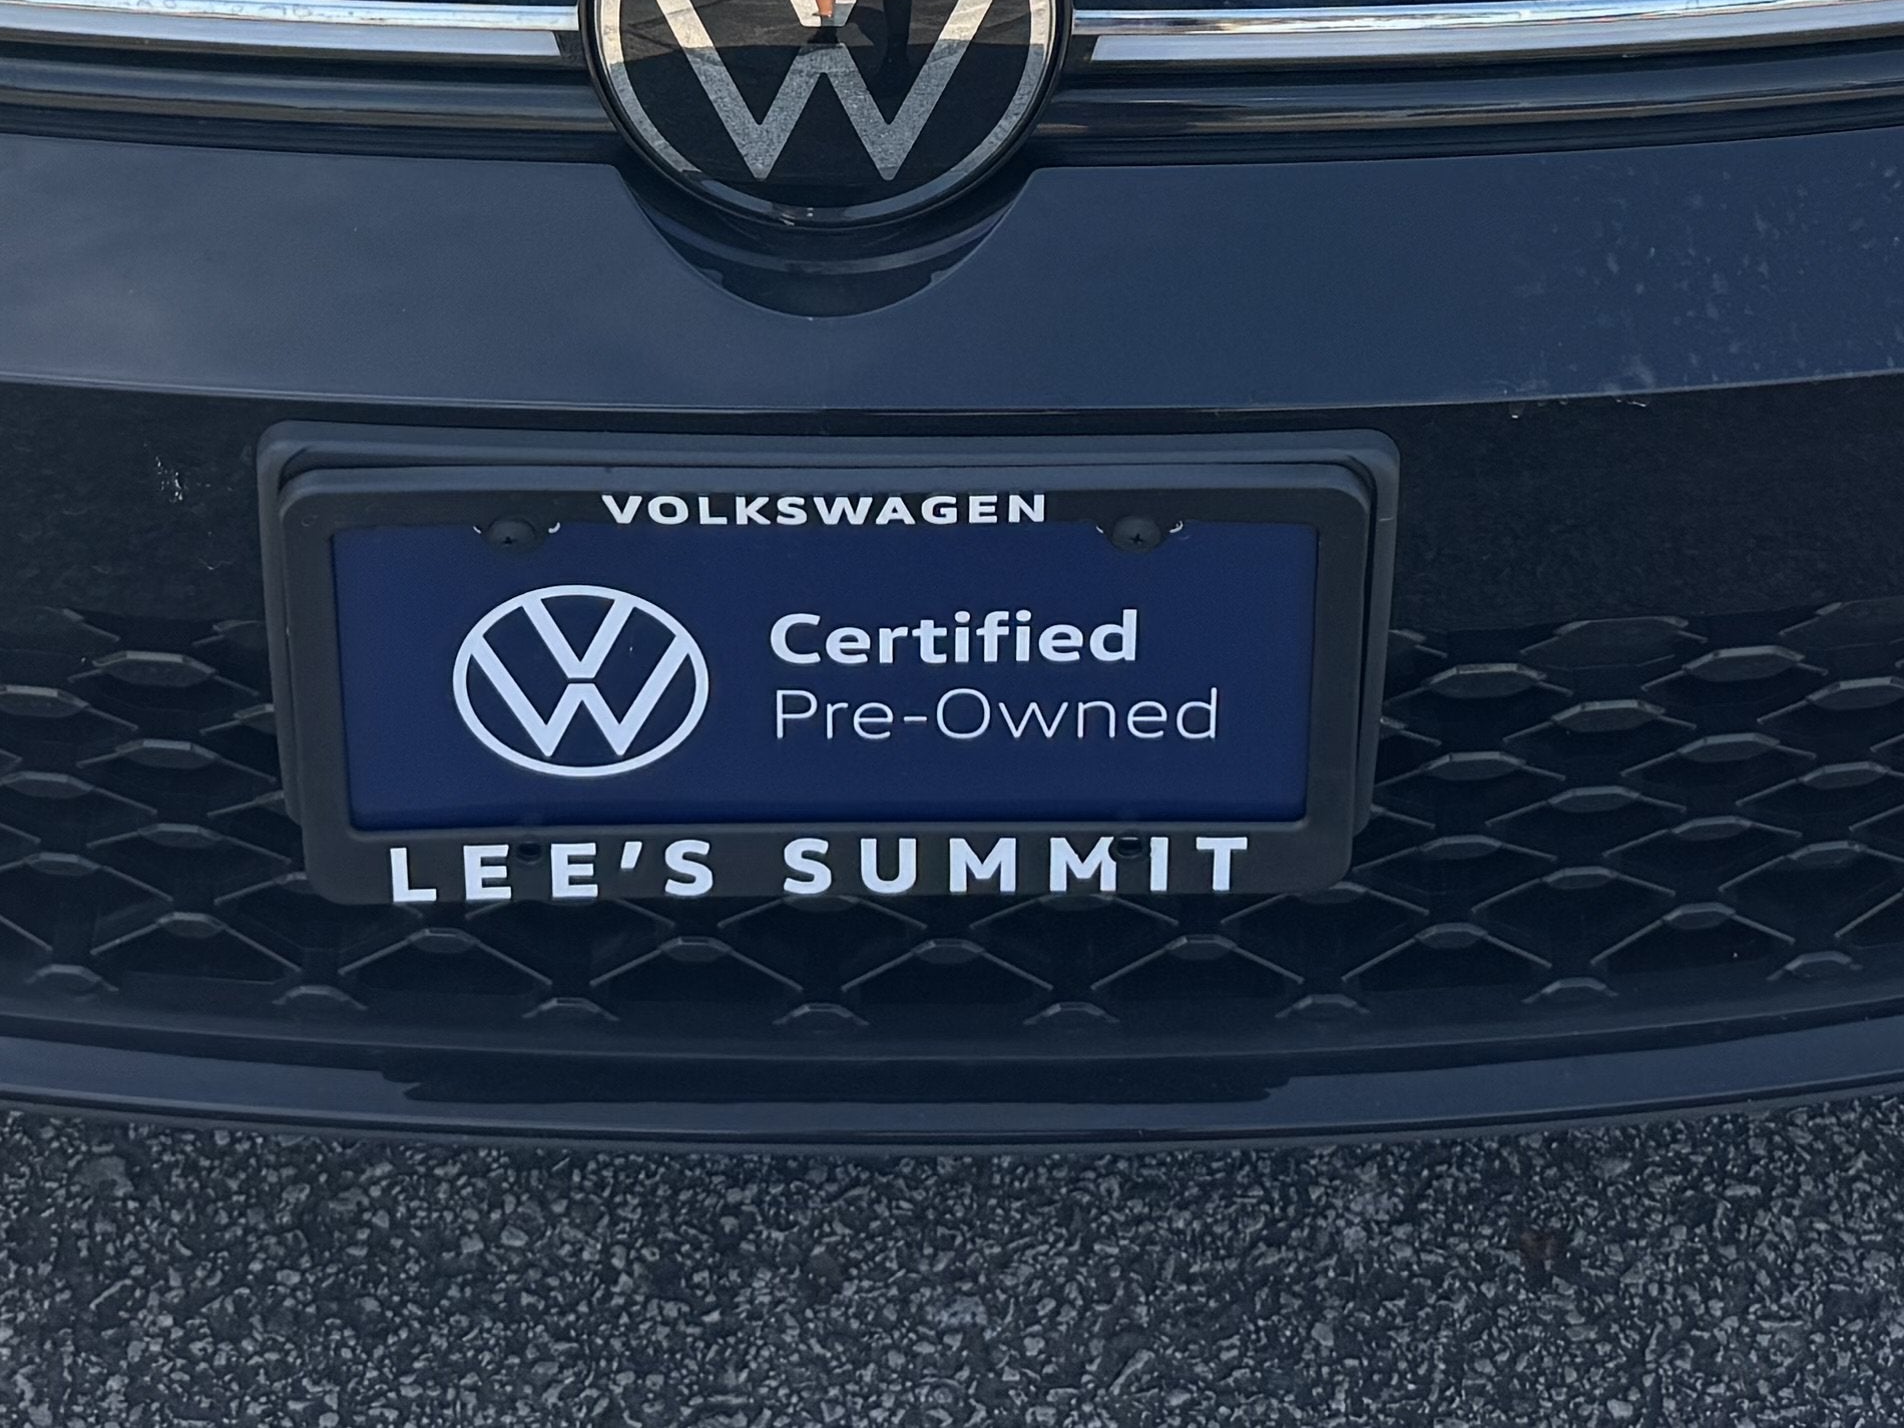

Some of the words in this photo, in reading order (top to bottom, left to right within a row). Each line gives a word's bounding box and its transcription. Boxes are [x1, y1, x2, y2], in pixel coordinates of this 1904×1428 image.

[600, 493, 1048, 526] VOLKSWAGEN
[769, 608, 1138, 666] Certified
[775, 686, 1219, 742] Pre-Owned
[389, 839, 715, 904] LEE'S
[782, 835, 1250, 896] SUMMIT
